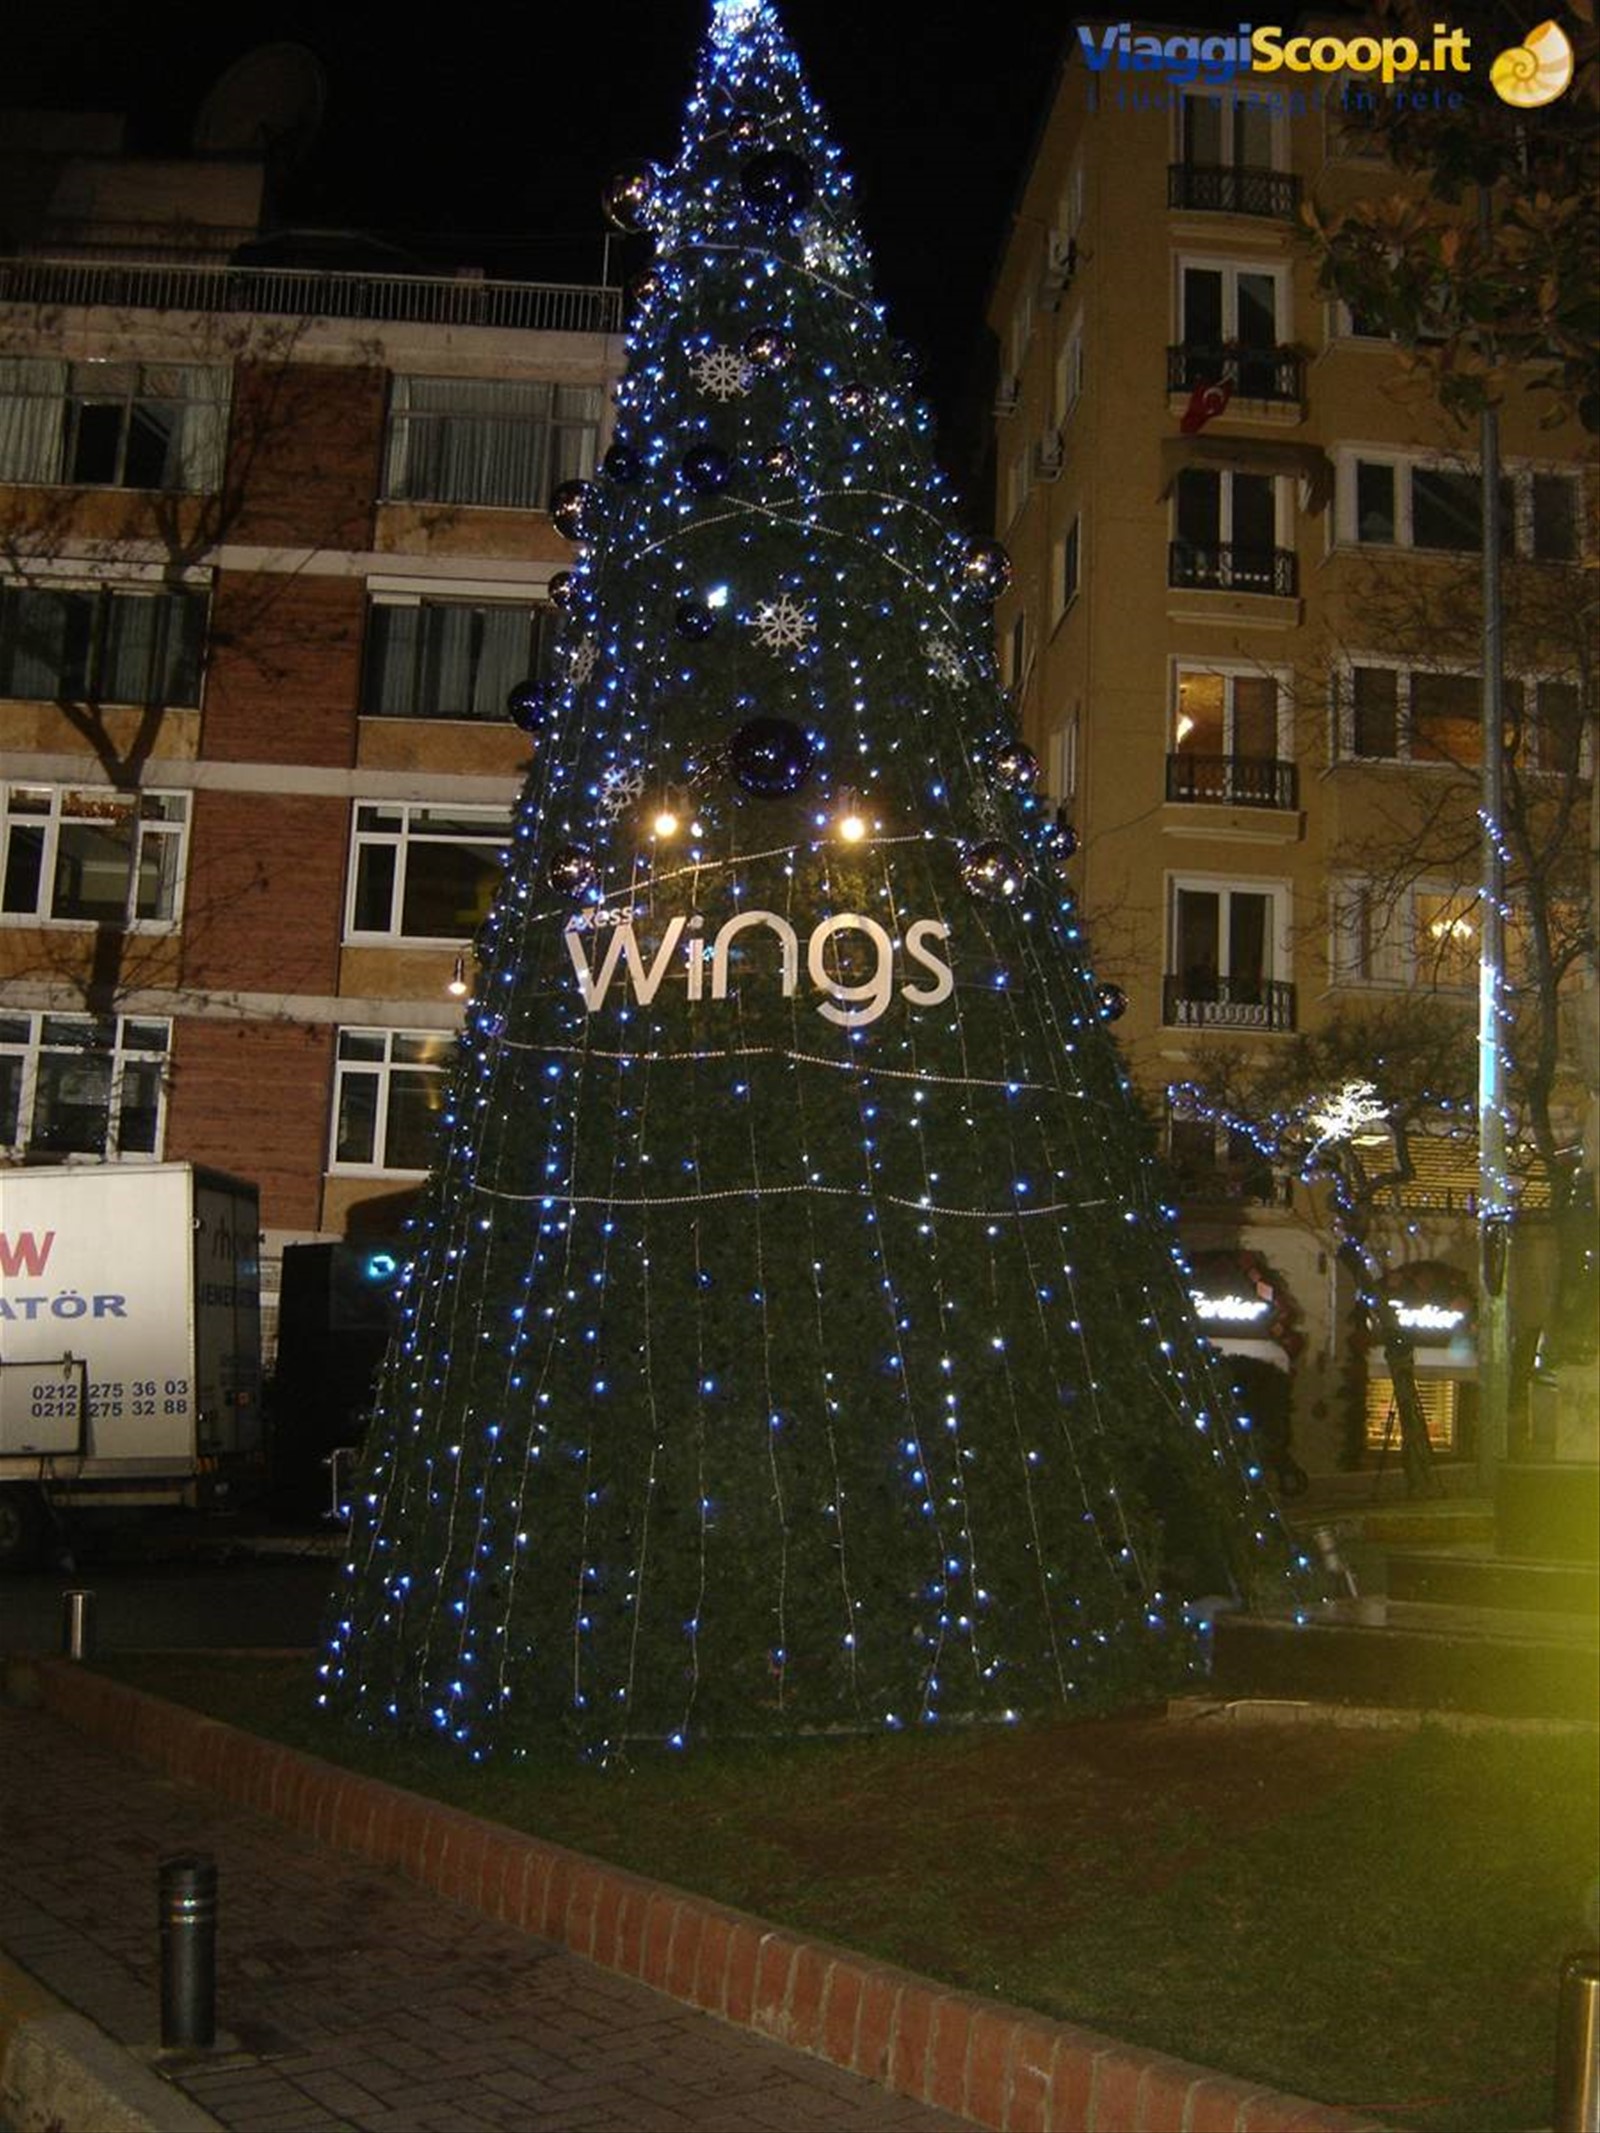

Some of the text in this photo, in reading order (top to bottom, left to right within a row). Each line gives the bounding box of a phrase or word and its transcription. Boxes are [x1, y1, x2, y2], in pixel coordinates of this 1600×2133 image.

[32, 1380, 188, 1400] 0212 275 36 03
[31, 1399, 188, 1417] 0212 275 32 88
